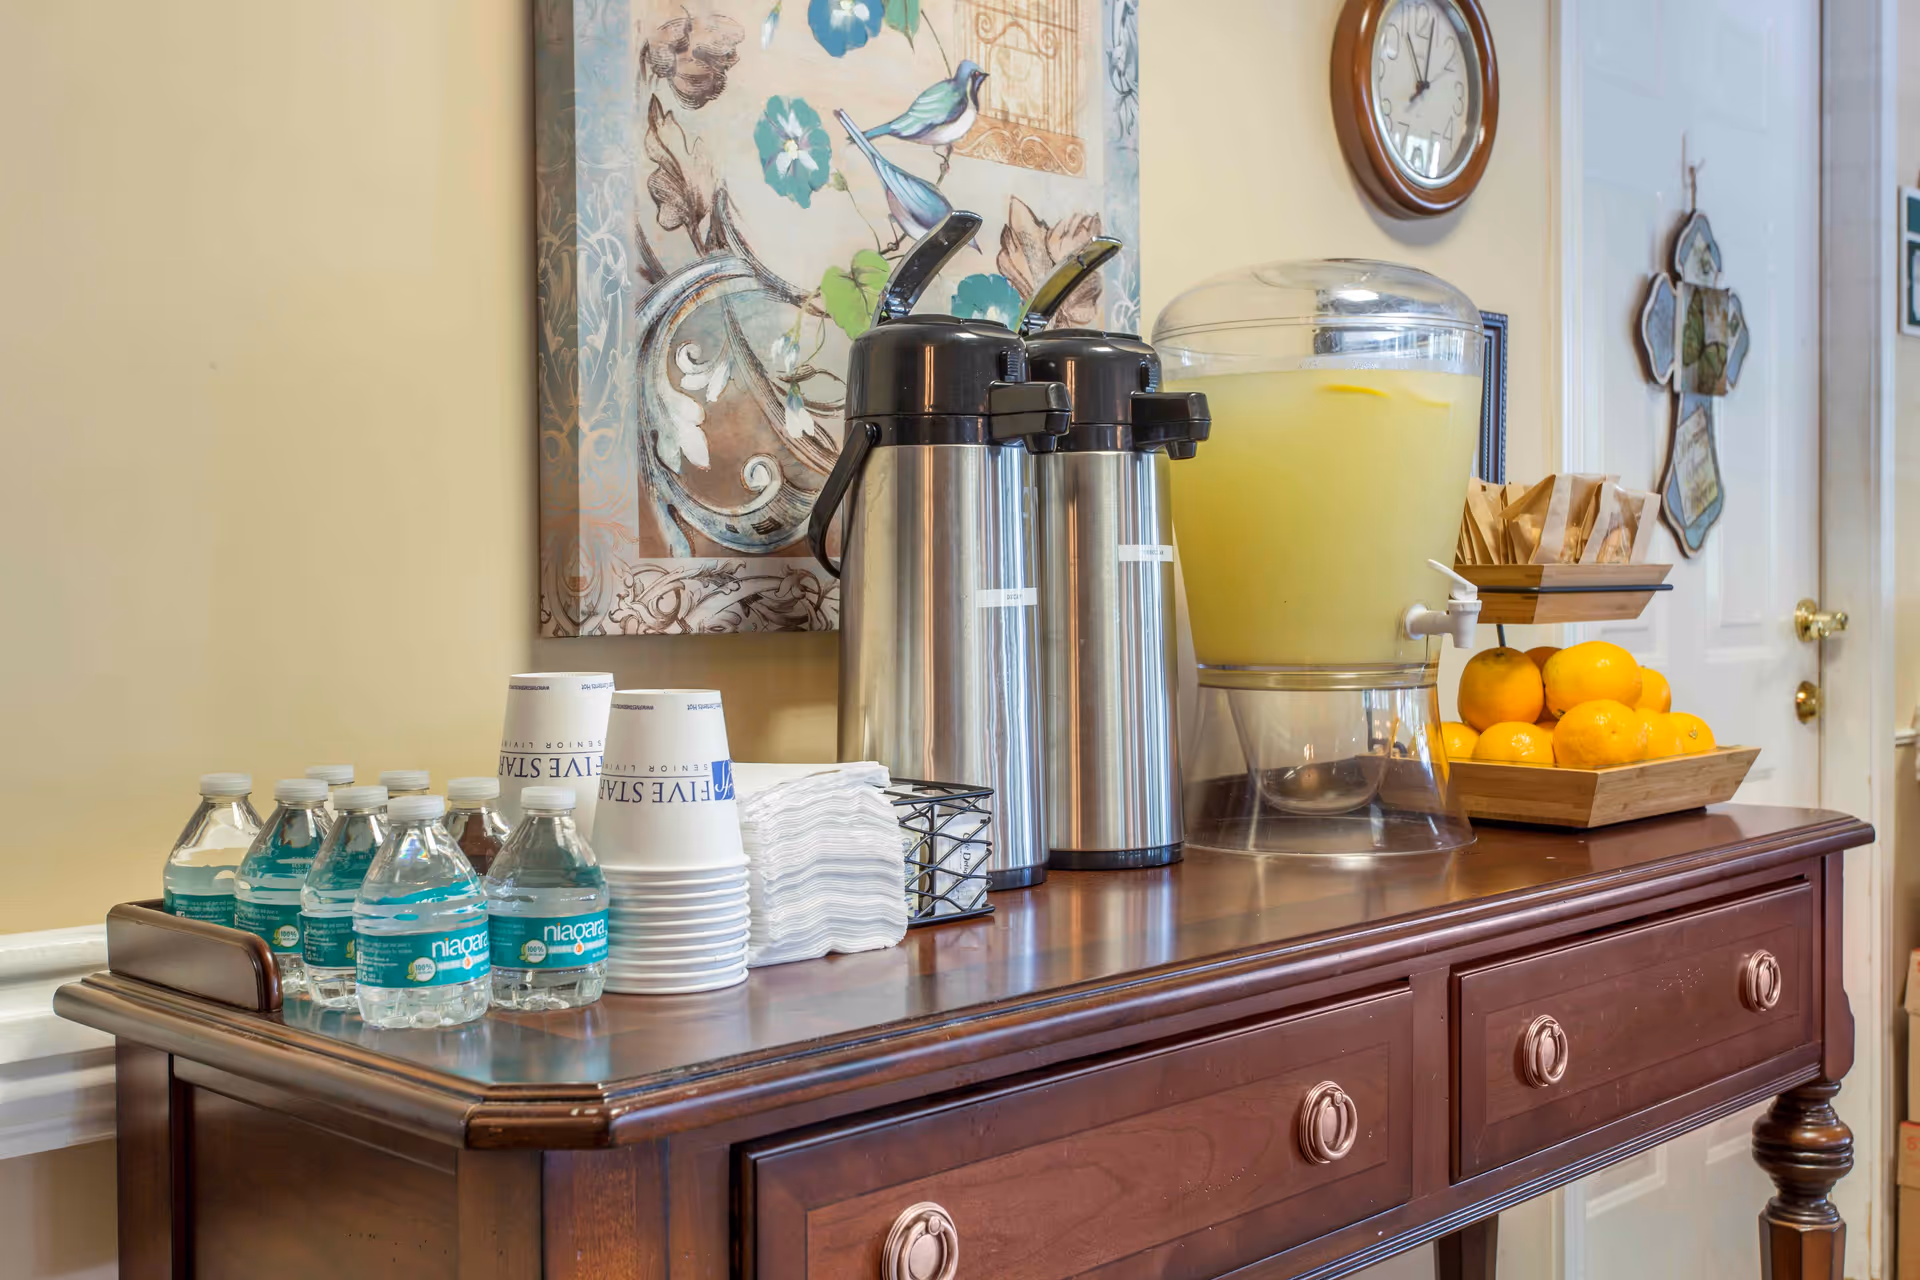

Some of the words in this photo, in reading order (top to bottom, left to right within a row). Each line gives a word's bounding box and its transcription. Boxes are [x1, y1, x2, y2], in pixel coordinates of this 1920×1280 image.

[1443, 35, 1457, 73] 2
[1453, 80, 1465, 117] 3
[1397, 121, 1410, 155] 7
[1442, 115, 1454, 152] 4
[544, 740, 602, 750] SENIOR
[549, 755, 603, 778] FIVE
[648, 763, 708, 773] SENIOR
[600, 780, 643, 804] STAR
[652, 780, 711, 803] FIVE
[543, 918, 607, 946] niagara
[527, 945, 544, 953] 100%
